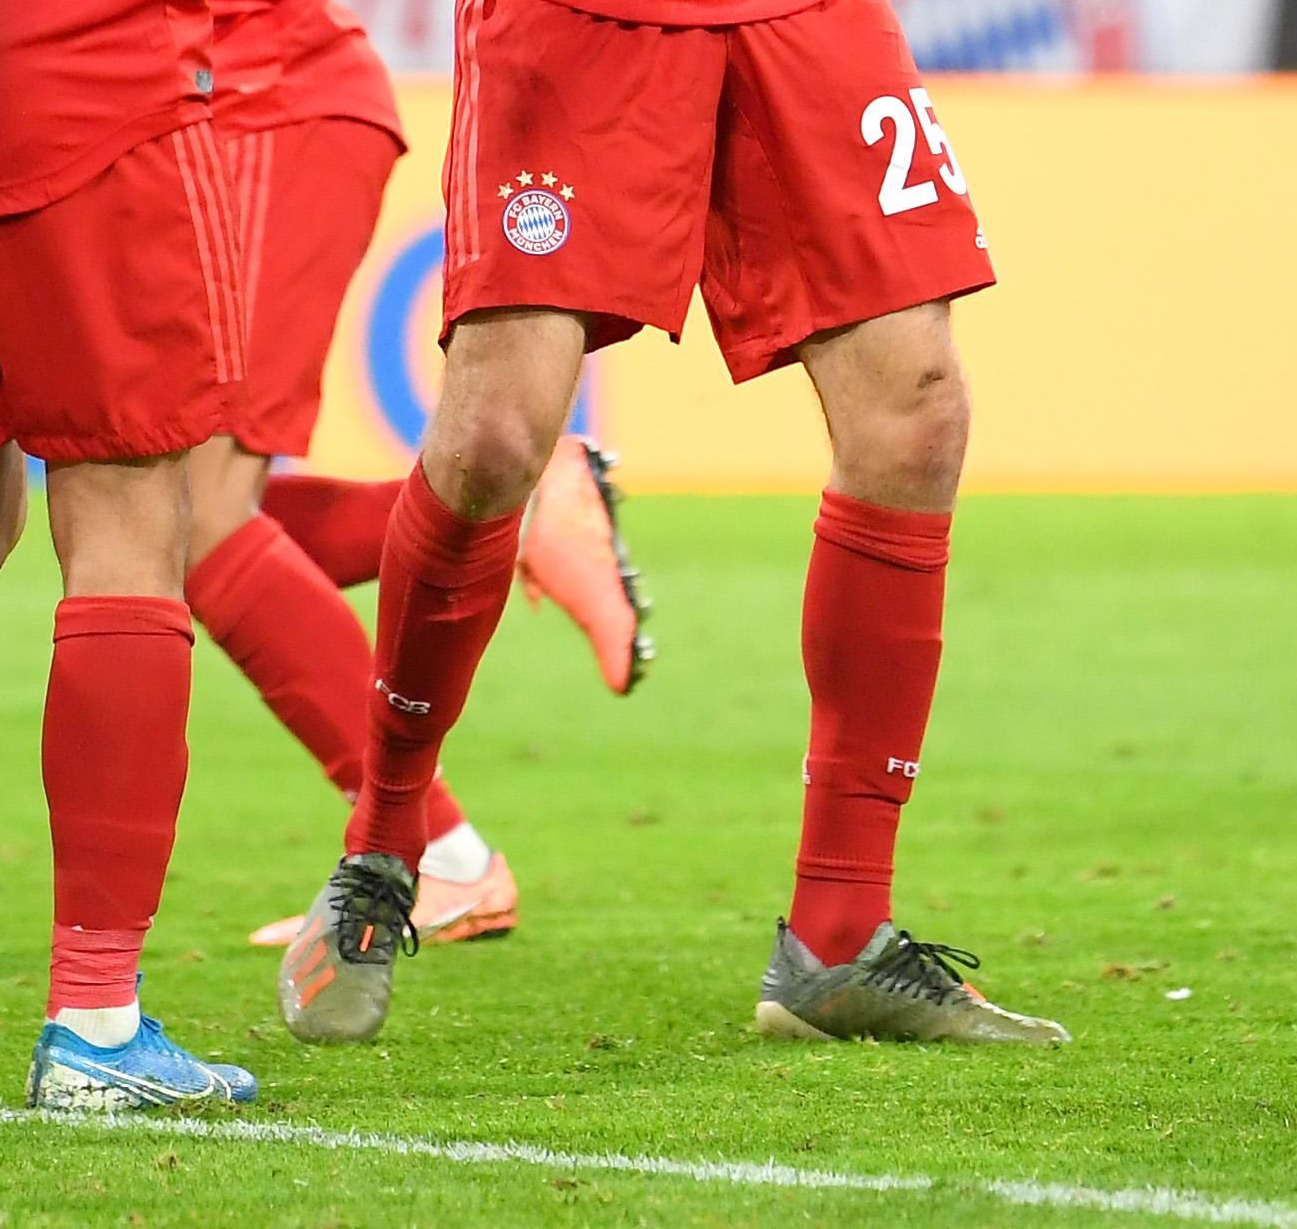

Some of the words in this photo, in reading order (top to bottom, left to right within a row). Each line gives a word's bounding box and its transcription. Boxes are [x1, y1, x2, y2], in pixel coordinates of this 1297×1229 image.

[860, 87, 967, 217] 25
[521, 194, 564, 221] BAYERN
[886, 756, 920, 779] FC
